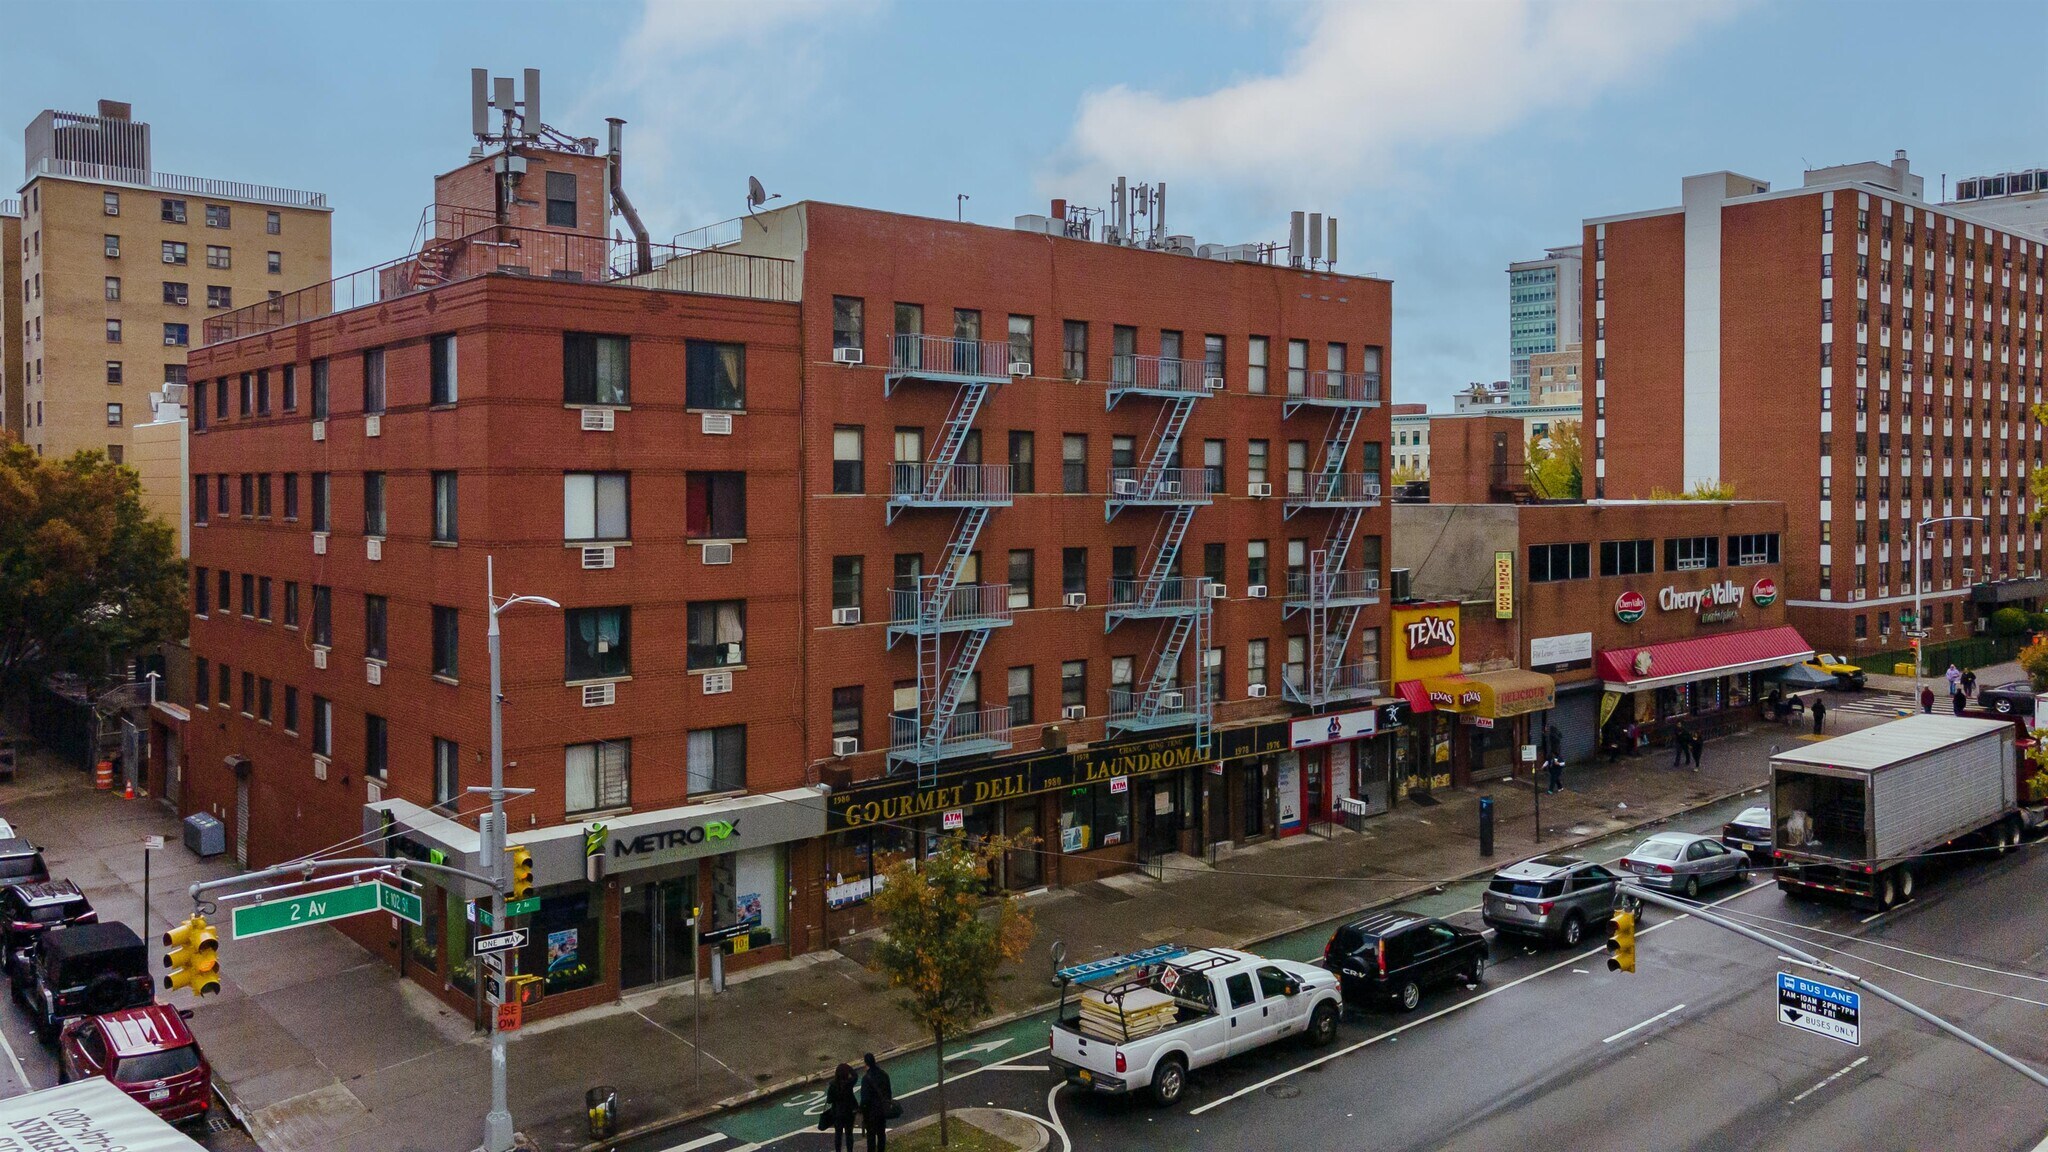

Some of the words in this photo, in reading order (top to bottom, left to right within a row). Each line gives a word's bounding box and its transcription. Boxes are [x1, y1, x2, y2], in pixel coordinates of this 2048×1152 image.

[1659, 586, 1704, 613] Cherry
[1711, 580, 1744, 608] Valley
[1408, 616, 1455, 650] TEXAS
[1430, 691, 1453, 704] TEXAS
[1463, 690, 1481, 704] TEXAS
[1044, 776, 1061, 788] 1980
[1112, 782, 1126, 790] ATM
[1071, 787, 1087, 796] ATM
[845, 785, 963, 826] GOURMET
[975, 774, 1024, 802] DELI
[944, 812, 962, 822] ATM
[385, 890, 390, 905] E
[391, 892, 401, 910] 102
[516, 902, 521, 913] 2
[290, 903, 301, 921] 2
[308, 900, 327, 918] Av
[482, 940, 498, 949] ONE
[504, 935, 520, 944] WAY
[1800, 982, 1820, 995] BUS
[1824, 989, 1852, 1004] LANE
[1782, 989, 1818, 1005] 7AM-10AM
[1822, 1000, 1855, 1016] 2PM-7PM
[1801, 1002, 1817, 1012] MON
[1823, 1009, 1836, 1018] FRI
[1805, 1016, 1831, 1030] BUSES
[1834, 1024, 1855, 1037] ONLY
